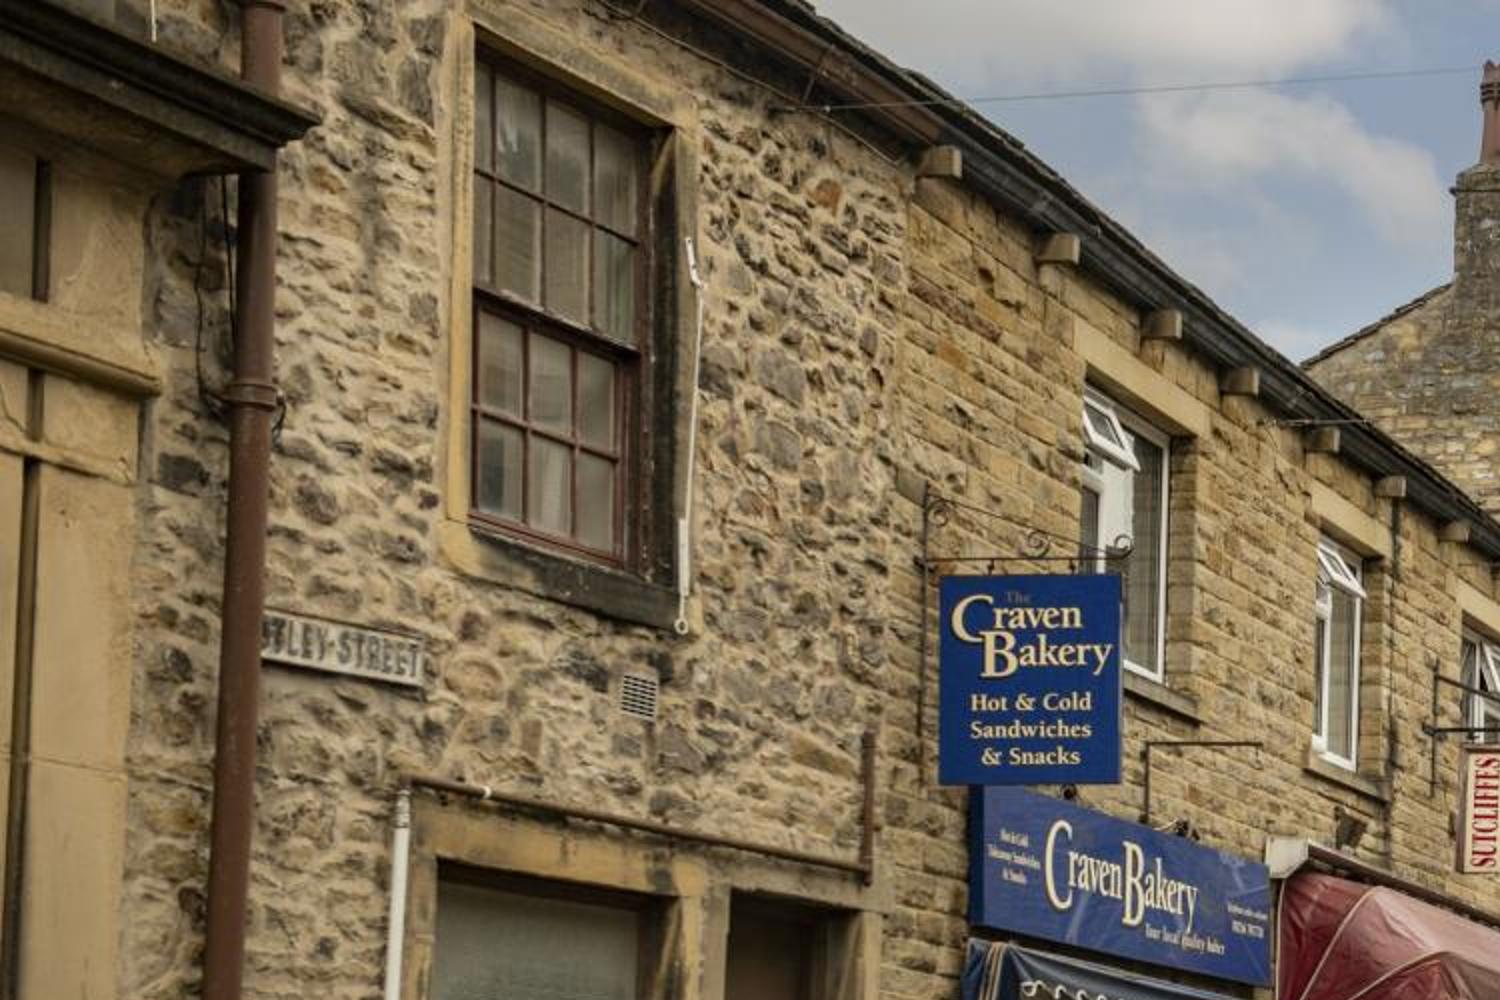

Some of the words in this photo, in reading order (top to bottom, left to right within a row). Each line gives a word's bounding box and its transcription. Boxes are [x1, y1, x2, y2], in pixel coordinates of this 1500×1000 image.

[951, 594, 1083, 643] Craven
[336, 630, 418, 677] STREET
[979, 630, 1113, 679] Bakery
[970, 694, 1008, 712] Hot
[1015, 693, 1036, 712] &
[1043, 691, 1092, 712] Cold
[970, 719, 1092, 740] Sandwiches
[981, 748, 1002, 766] &
[1009, 746, 1081, 766] Snacks
[1471, 757, 1500, 868] SUTCLIFFES
[1045, 819, 1122, 909] Craven
[1122, 840, 1199, 933] Bakery
